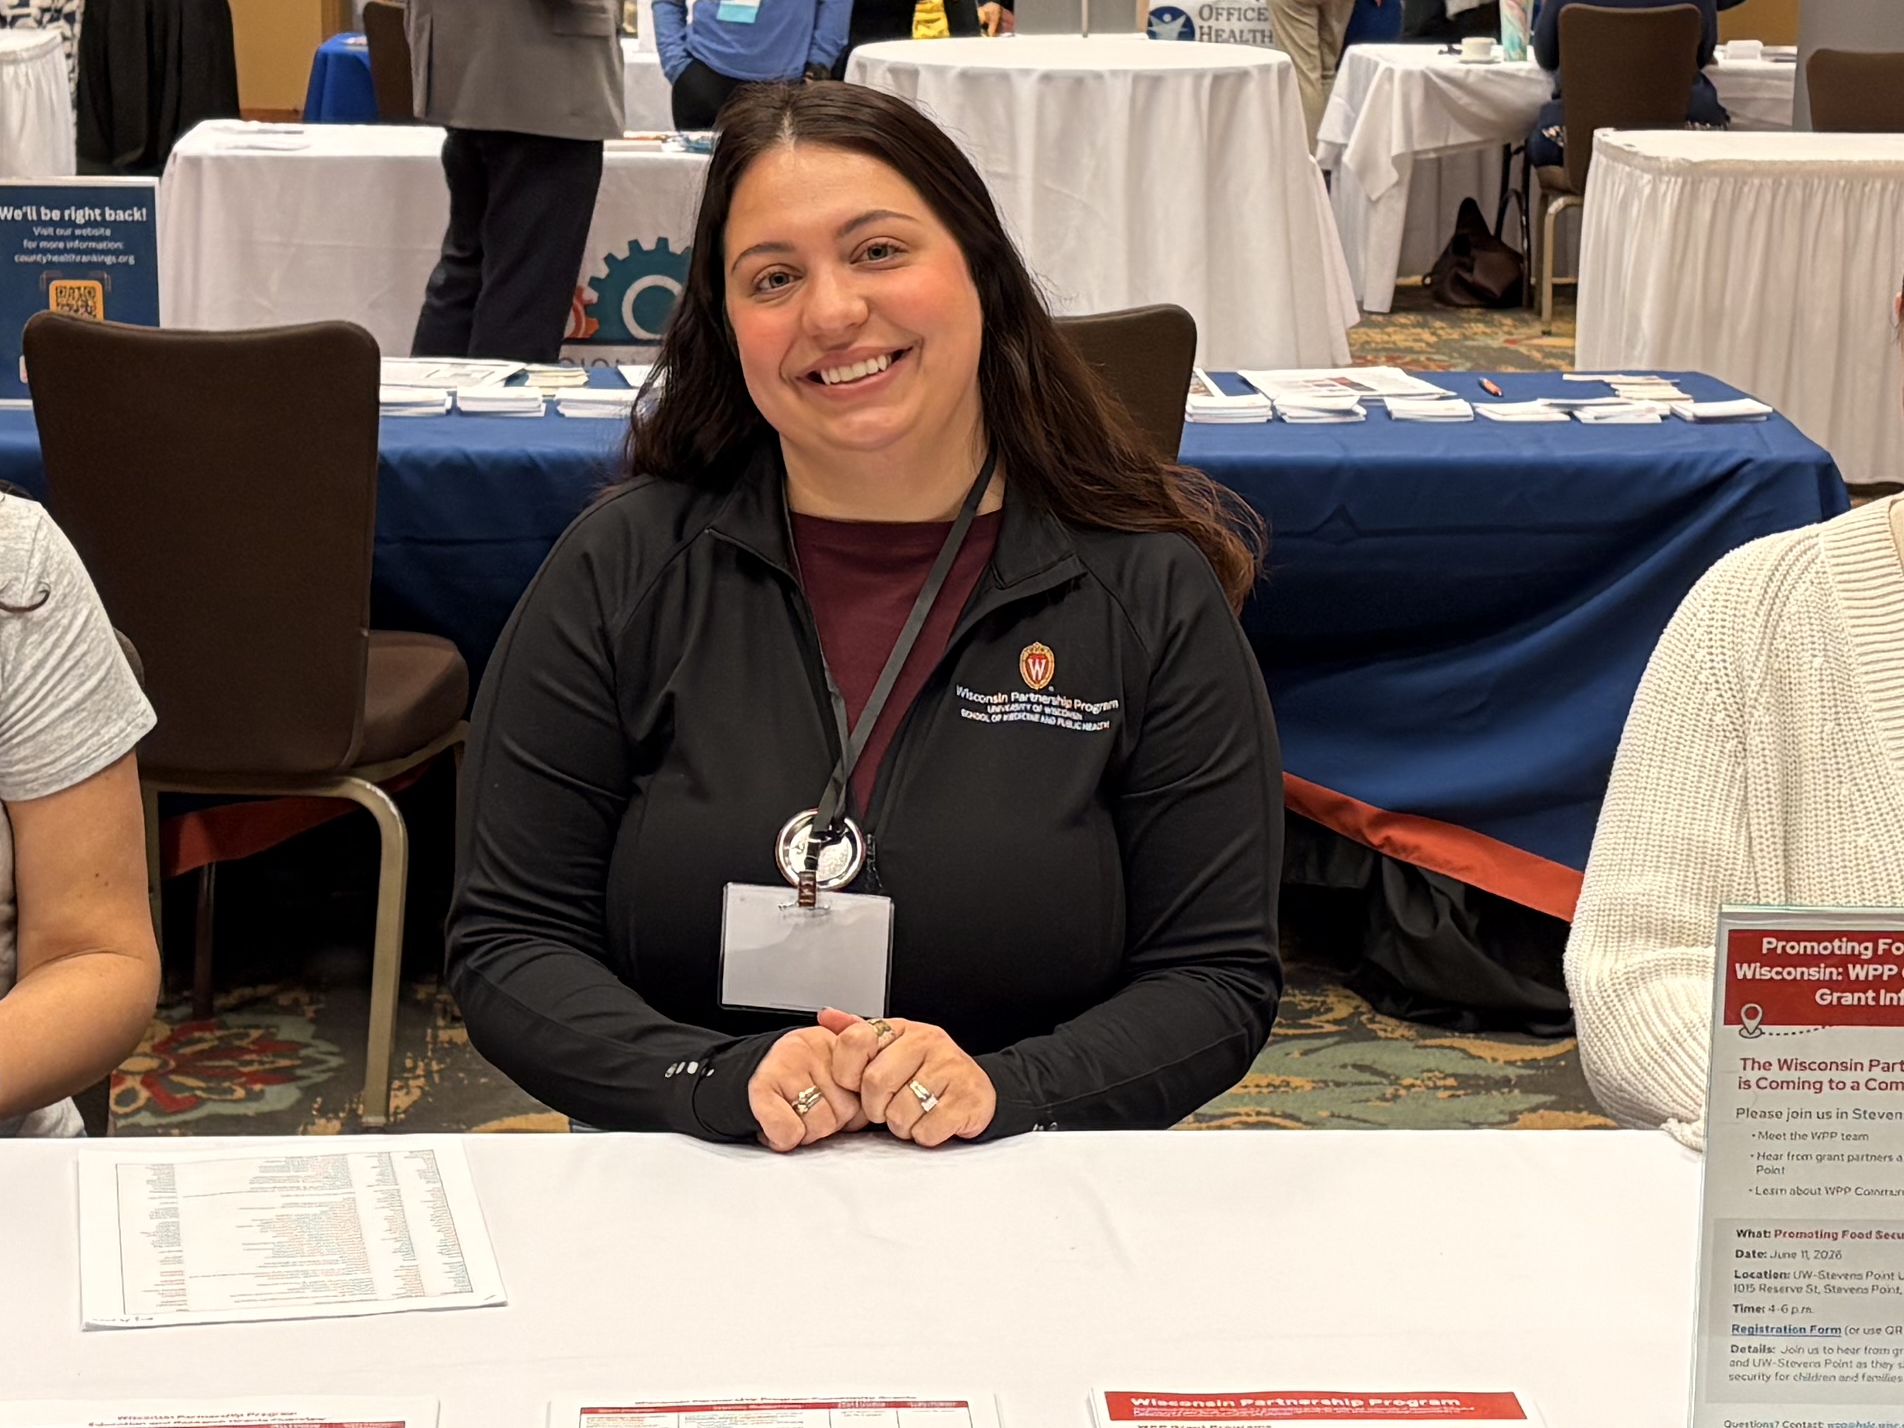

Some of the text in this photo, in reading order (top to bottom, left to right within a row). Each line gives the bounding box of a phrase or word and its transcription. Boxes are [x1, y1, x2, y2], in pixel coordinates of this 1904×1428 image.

[41, 206, 60, 221] be
[64, 206, 102, 225] right
[105, 206, 147, 221] back!
[33, 227, 54, 236] Visit
[75, 227, 111, 236] website
[23, 240, 37, 250] for
[39, 242, 64, 250] more
[14, 254, 135, 265] countyhealthrankings.org
[1028, 659, 1046, 681] W
[956, 684, 1119, 714] Wisconsin Partnership Program
[1762, 937, 1872, 959] Promoting
[1735, 962, 1842, 980] Wisconsin:
[1848, 964, 1898, 980] WPP
[1815, 988, 1875, 1005] Grant
[1740, 1057, 1772, 1071] The
[1777, 1058, 1863, 1071] Wisconsin
[1738, 1076, 1751, 1089] is
[1755, 1076, 1823, 1094] Coming
[1828, 1078, 1846, 1090] to
[1850, 1081, 1860, 1090] a
[1130, 1397, 1461, 1409] Wisconsin Partnership Program
